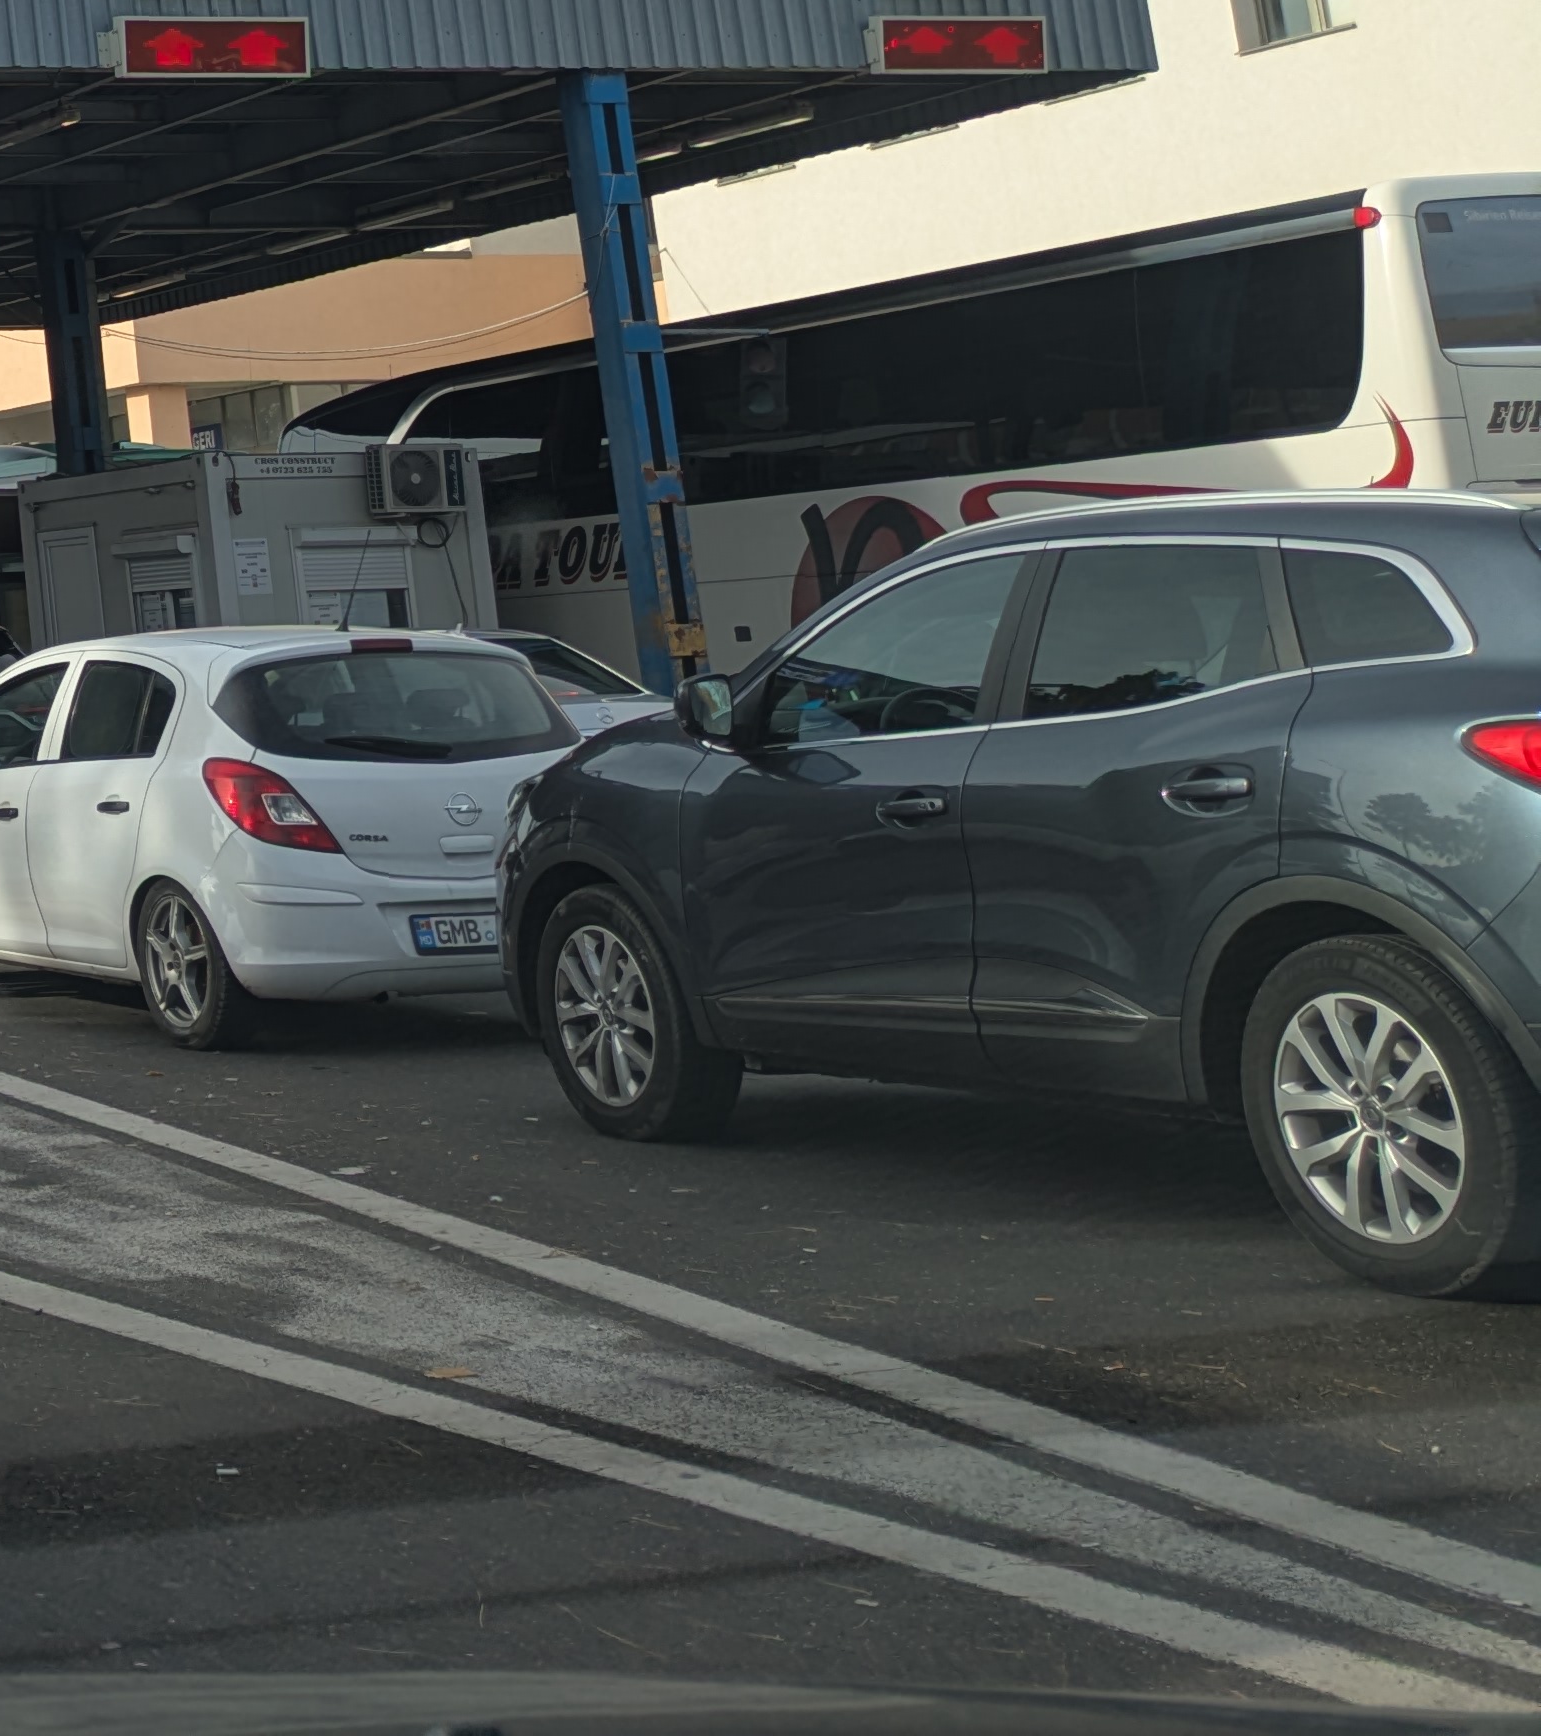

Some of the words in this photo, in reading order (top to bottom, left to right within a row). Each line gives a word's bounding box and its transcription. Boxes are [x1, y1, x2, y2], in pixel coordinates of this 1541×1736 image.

[281, 457, 336, 465] CONSTRUCT
[348, 833, 389, 843] CORSA
[435, 919, 482, 945] GMB
